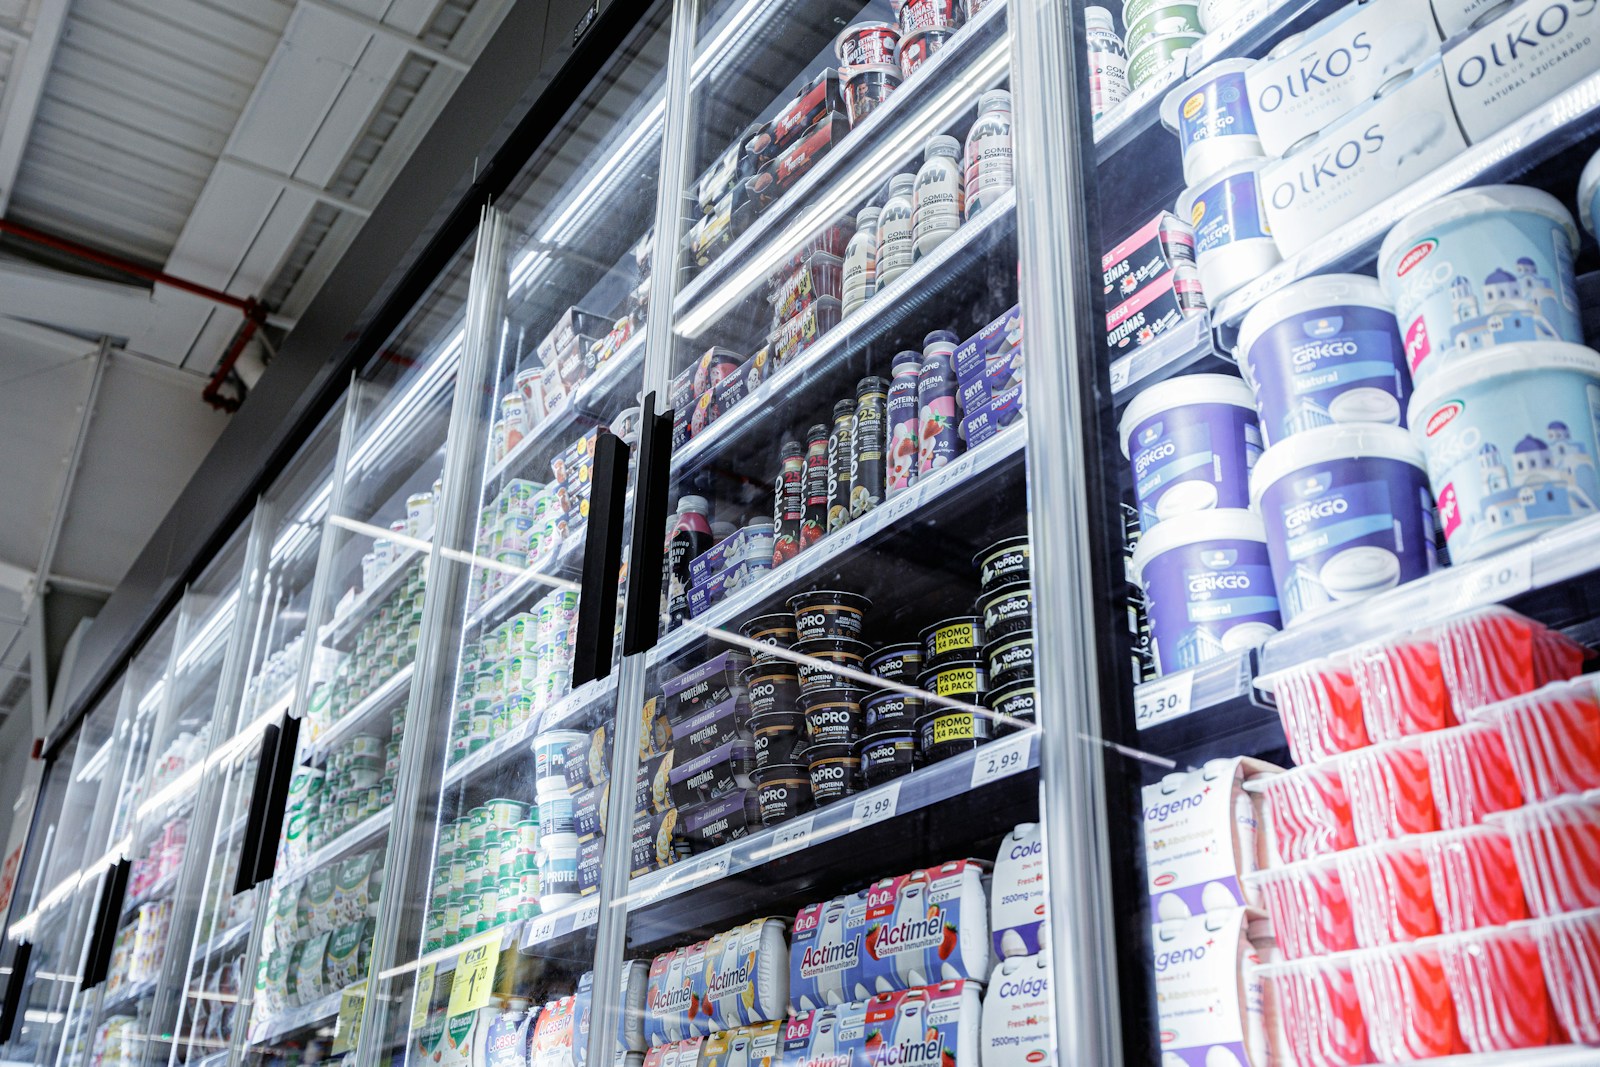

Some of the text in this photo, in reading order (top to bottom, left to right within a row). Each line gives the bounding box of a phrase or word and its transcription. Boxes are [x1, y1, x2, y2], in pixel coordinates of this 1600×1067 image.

[1259, 32, 1371, 112] OIKOS
[1484, 37, 1591, 107] NATURAL AZUCARADO
[1272, 124, 1385, 210] OIKOS
[923, 193, 953, 202] COMIDA
[957, 343, 977, 362] SKYR
[964, 379, 983, 400] SKYR
[968, 412, 989, 433] SKYR
[693, 560, 705, 574] SKYR
[691, 590, 705, 603] SKYR
[937, 626, 970, 639] PROMO
[949, 637, 971, 646] PACK
[939, 671, 974, 683] PROMO
[951, 680, 974, 690] PACK
[680, 681, 709, 702] PROTEÍNAS
[936, 716, 971, 729] PROMO
[948, 725, 971, 735] PACK
[690, 724, 718, 745] PROTEÍNAS
[687, 769, 714, 790] PROTEÍNAS
[702, 819, 728, 838] PROTEÍNAS
[1002, 892, 1029, 905] 2500mg
[876, 917, 944, 948] Actimel
[801, 934, 861, 969] Actimel
[708, 962, 749, 993] Actimel
[653, 981, 693, 1010] Actimel
[875, 1032, 942, 1067] Actimel
[992, 1037, 1019, 1046] 2500mg
